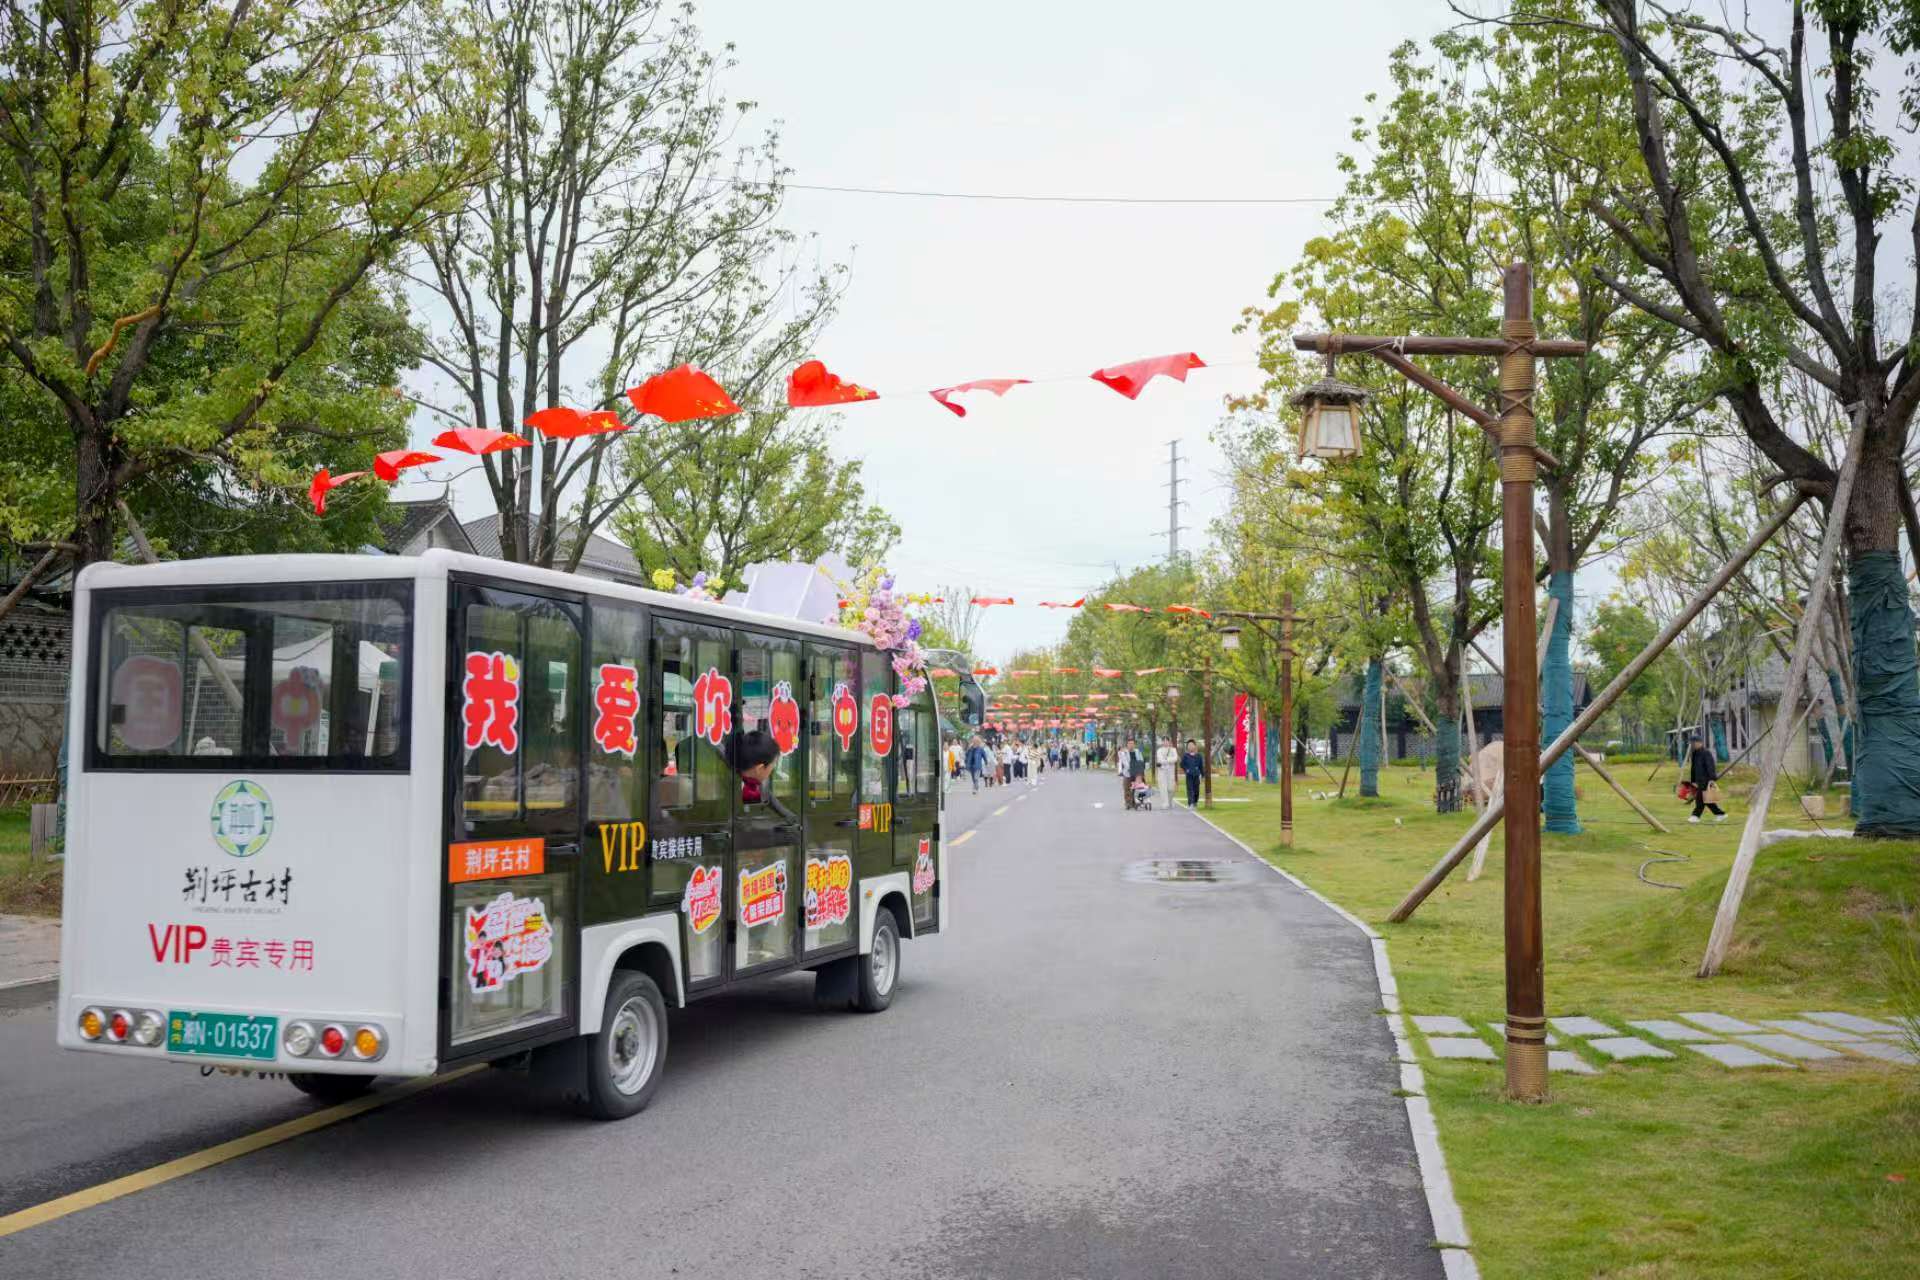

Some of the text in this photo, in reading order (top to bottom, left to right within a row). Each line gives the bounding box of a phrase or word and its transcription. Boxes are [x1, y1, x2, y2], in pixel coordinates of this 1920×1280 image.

[463, 652, 892, 756] 我 爱 你 中 国
[873, 803, 892, 832] VIP
[466, 846, 530, 874] 荆坪古村
[599, 822, 645, 873] VIP
[182, 867, 292, 904] 荆坪古村
[149, 924, 315, 971] VIP 贵宾专用
